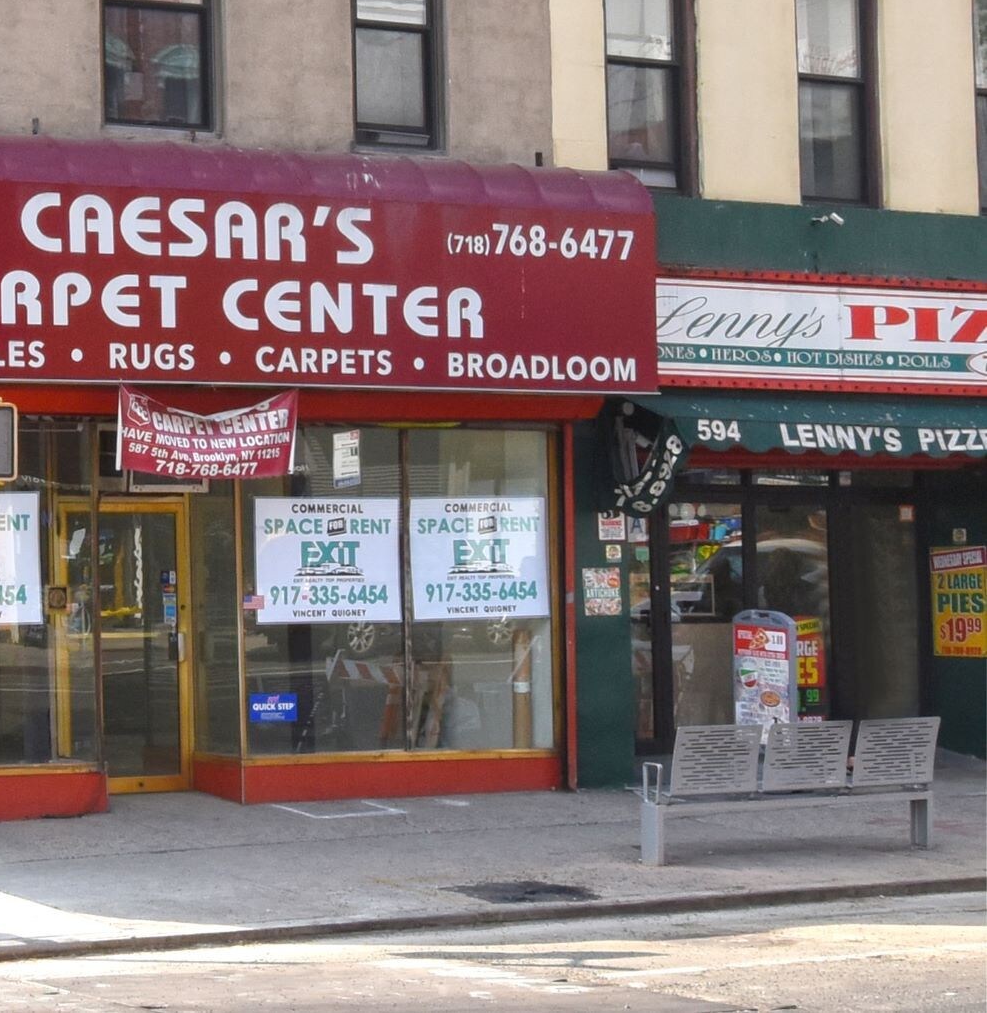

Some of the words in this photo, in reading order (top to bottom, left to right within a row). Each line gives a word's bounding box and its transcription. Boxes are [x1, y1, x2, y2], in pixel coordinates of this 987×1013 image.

[20, 192, 374, 265] CAESAR'S
[492, 223, 634, 260] 768-6477
[222, 278, 484, 338] CENTER
[657, 296, 825, 347] Lenny's
[109, 343, 195, 370] RUGS
[255, 346, 392, 374] CARPETS
[447, 352, 637, 382] BROADLOOM
[711, 348, 772, 362] HEROS
[787, 351, 822, 365] HOT
[826, 353, 884, 367] DISHES
[898, 355, 951, 368] ROLLS
[152, 413, 214, 436] CARPET
[220, 409, 289, 434] CENTER
[122, 426, 152, 441] HAVE
[156, 434, 190, 448] MOVED
[192, 437, 207, 449] TO
[211, 437, 236, 449] NEW
[240, 432, 290, 447] LOCATION
[697, 419, 741, 442] 594
[779, 423, 902, 452] LENNY'S
[128, 443, 147, 454] 587
[151, 447, 168, 459] 5th
[193, 450, 239, 464] Brooklyn,
[241, 450, 255, 460] NY
[257, 447, 280, 459] 11215
[155, 459, 258, 477] 718-768-6477
[291, 504, 363, 514] COMMERCIAL
[445, 502, 513, 513] COMMERCIAL
[264, 518, 323, 534] SPACE
[328, 519, 344, 531] FOR
[350, 518, 391, 534] RENT
[417, 517, 474, 534] SPACE
[499, 516, 540, 533] RENT
[937, 573, 946, 589] 2
[947, 573, 982, 589] LARGE
[270, 585, 388, 605] 917-335-6454
[425, 581, 537, 602] 917-335-6454
[292, 610, 326, 618] VINCENT
[331, 609, 367, 617] QUIGNEY
[447, 606, 479, 614] VINCENT
[937, 593, 984, 614] PIES
[797, 640, 818, 656] RGE
[797, 657, 818, 684] ES
[252, 703, 276, 711] QUICK
[277, 702, 295, 710] STEP
